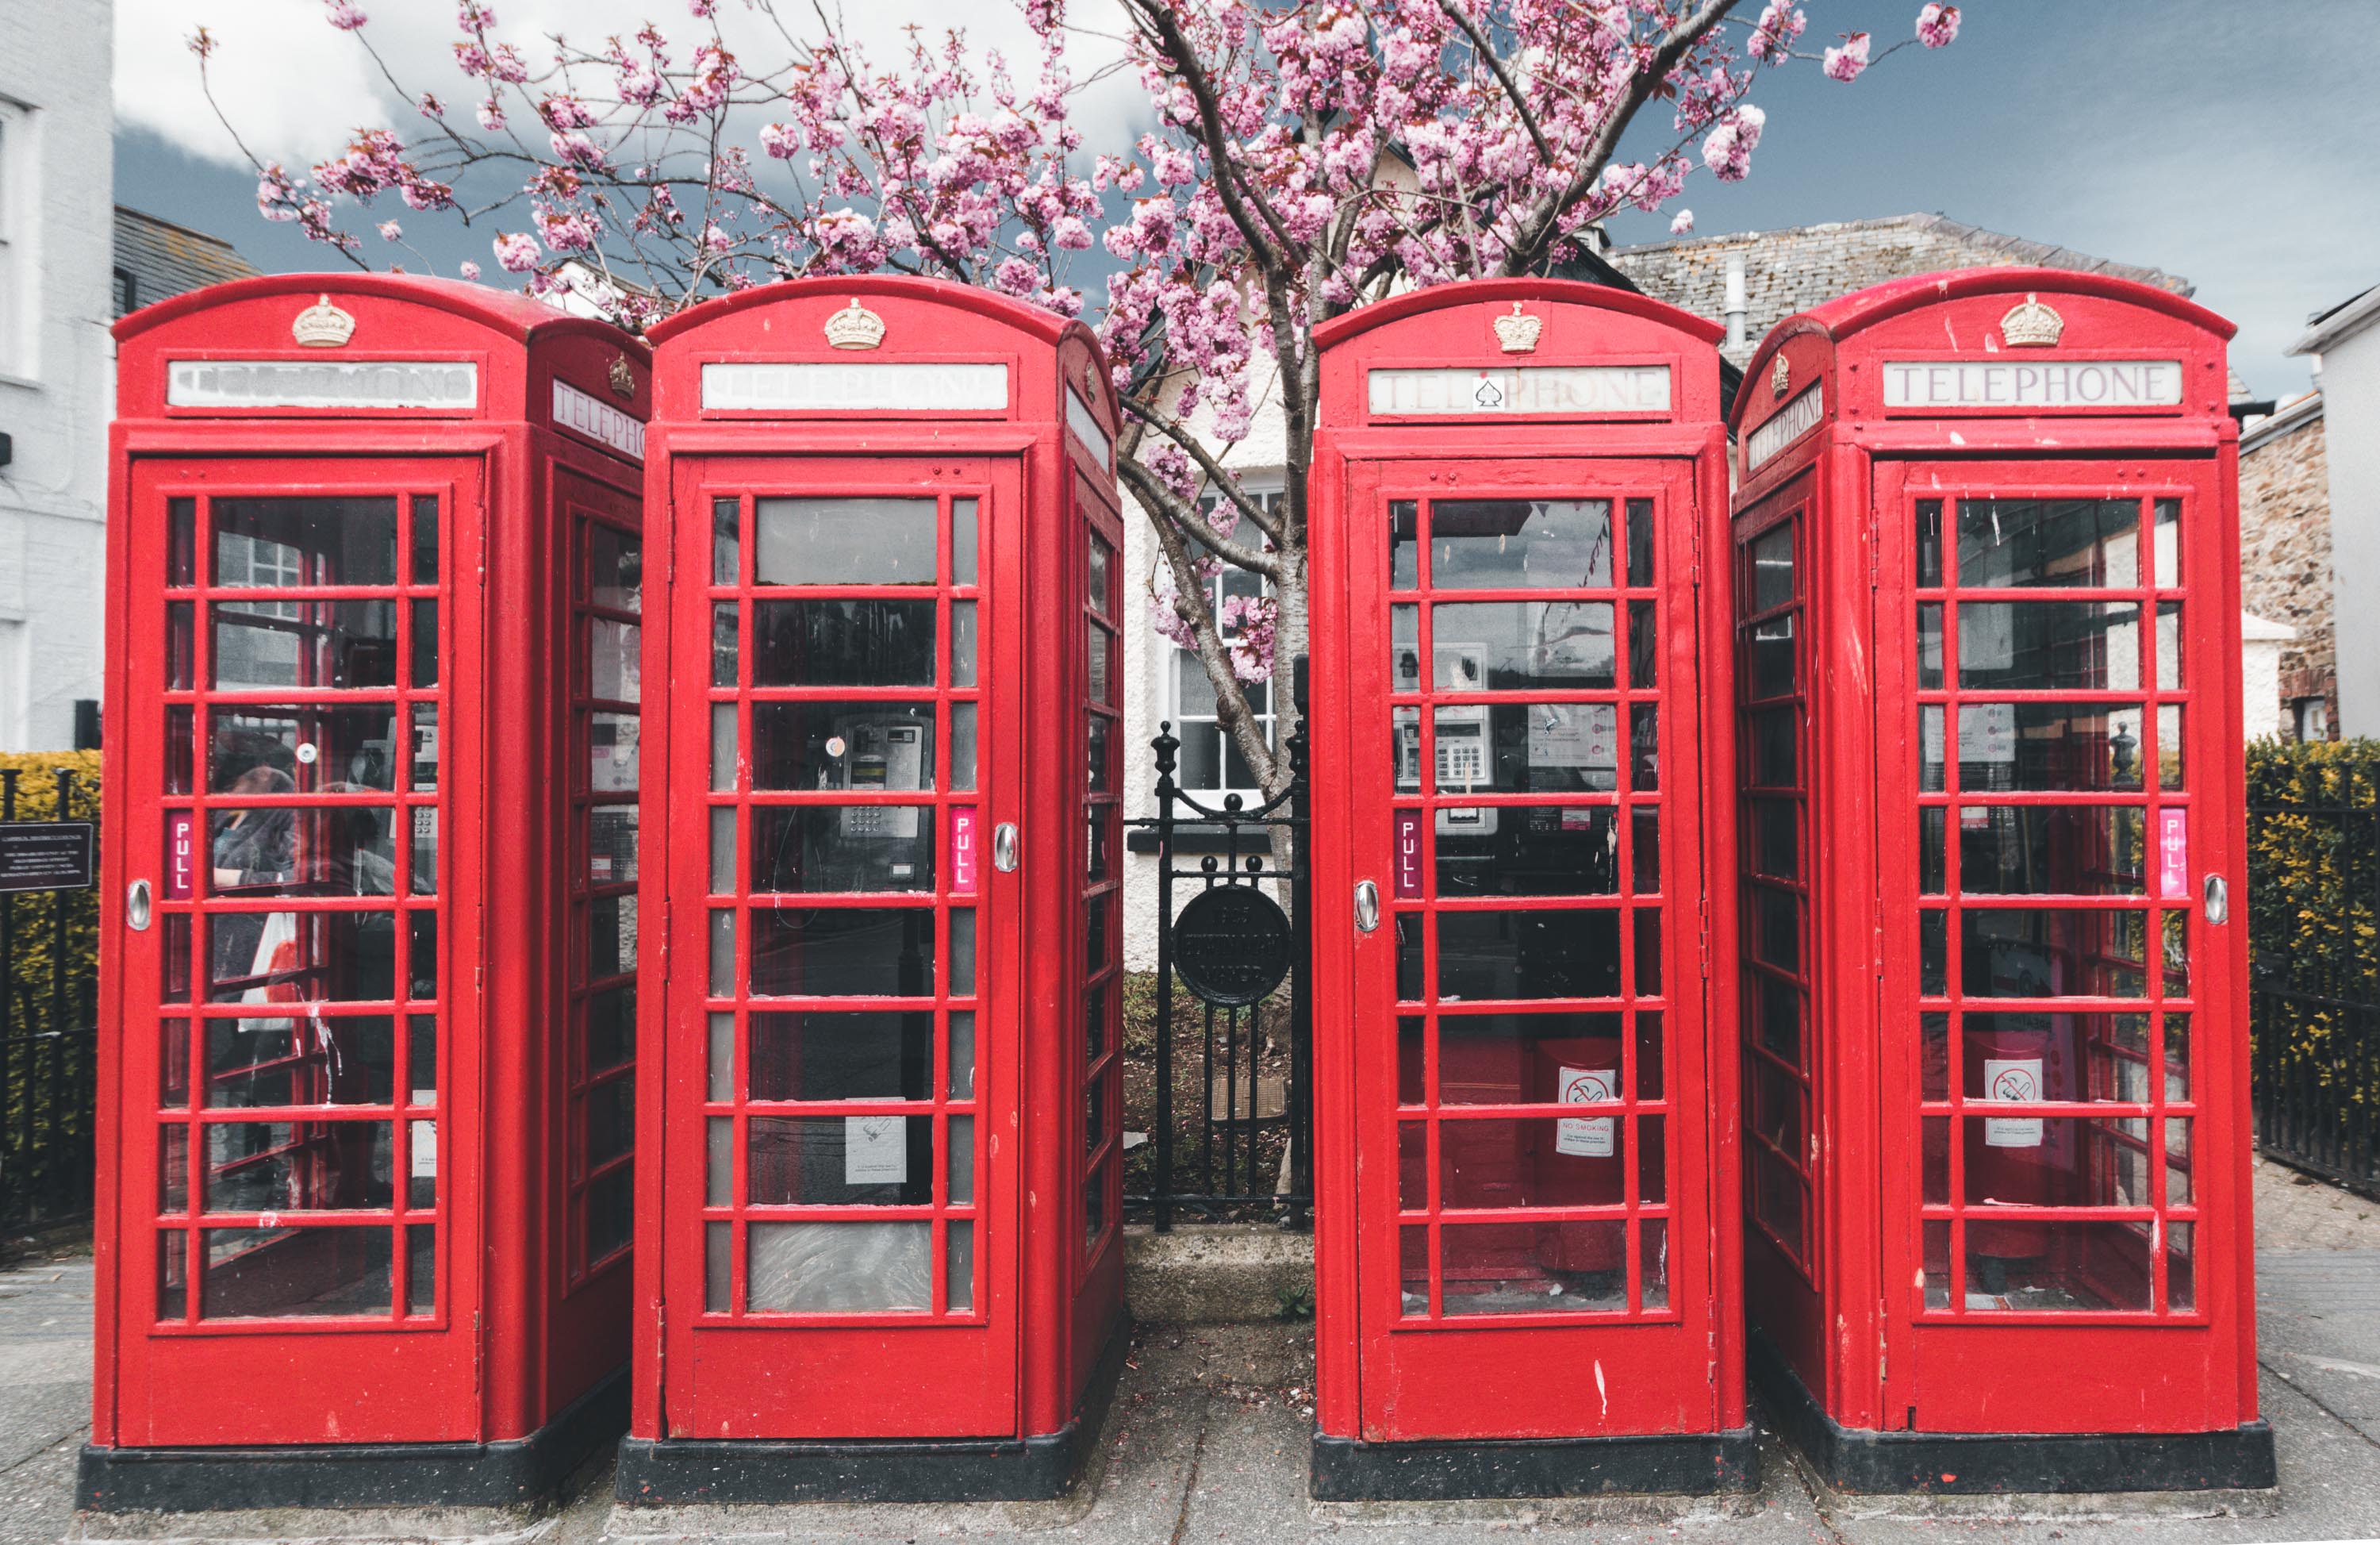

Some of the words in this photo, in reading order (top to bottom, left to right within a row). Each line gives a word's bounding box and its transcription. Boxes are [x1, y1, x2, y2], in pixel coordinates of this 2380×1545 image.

[1381, 371, 1659, 409] TELPHONE
[1893, 367, 2166, 402] TELEPHONE
[177, 823, 189, 889] PULL
[958, 816, 969, 883] PULL
[1403, 822, 1415, 887] PULL
[2167, 820, 2179, 885] PULL
[1576, 1124, 1610, 1132] SMOKING
